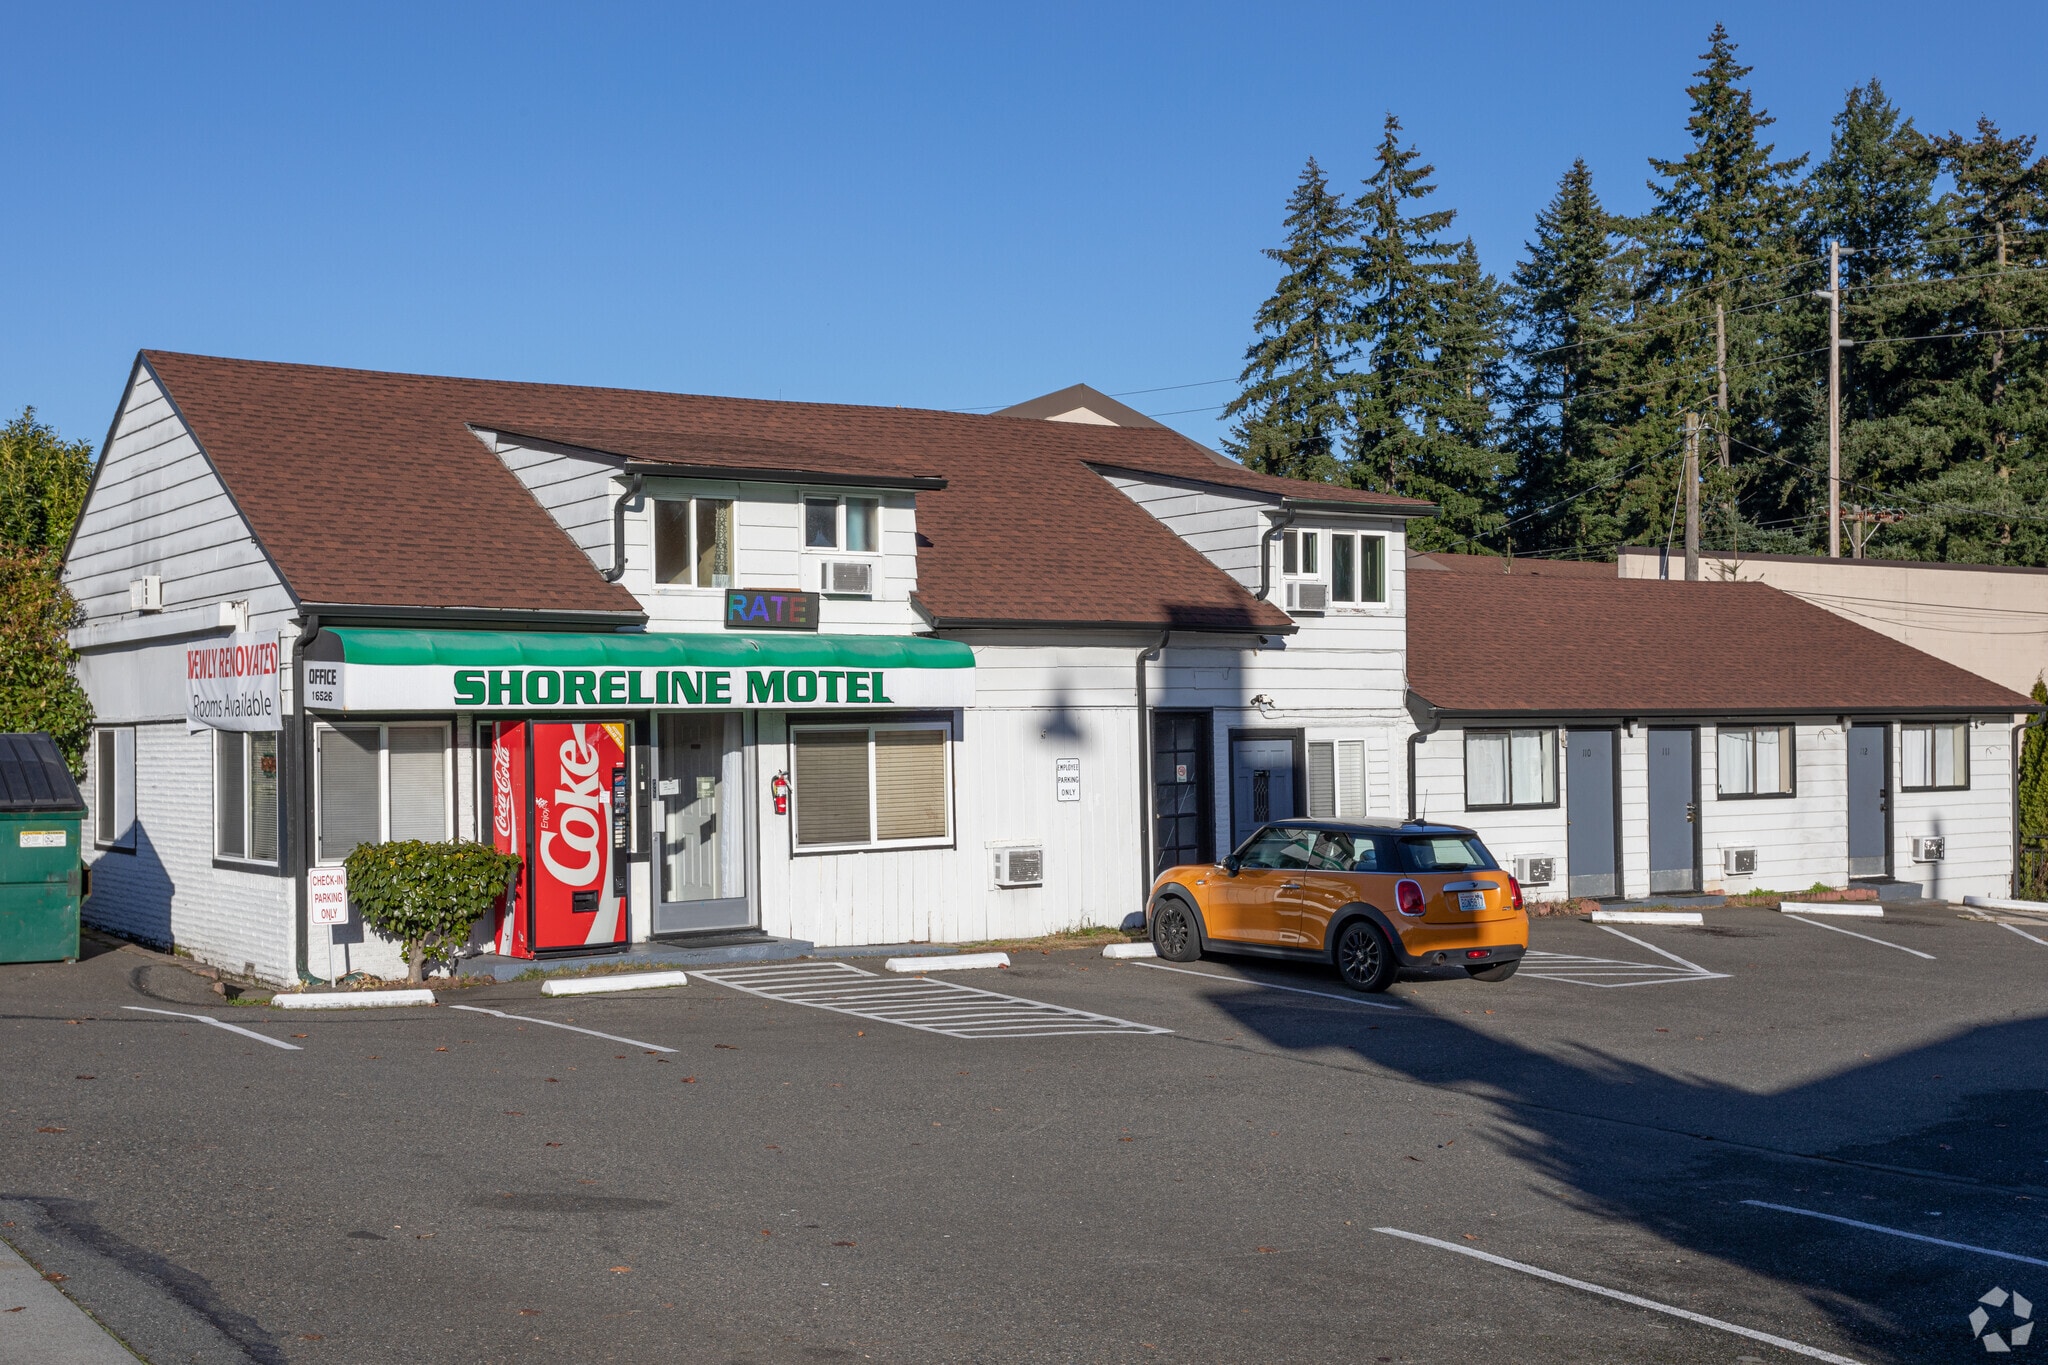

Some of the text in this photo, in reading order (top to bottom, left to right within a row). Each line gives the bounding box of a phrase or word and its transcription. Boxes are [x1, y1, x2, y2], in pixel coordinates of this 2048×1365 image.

[728, 594, 807, 623] RATE
[187, 641, 278, 680] NEWLY RENOVATED
[309, 668, 336, 686] OFFICE
[454, 669, 895, 706] SHORELINE MOTEL
[312, 691, 333, 702] 16526
[193, 690, 272, 718] Rooms Available
[1582, 748, 1591, 758] 110
[1662, 747, 1670, 756] 111
[1057, 763, 1079, 771] EMPLOYEE
[540, 738, 600, 887] Coke
[540, 804, 551, 829] Enjoy
[312, 875, 343, 886] CHECK-IN
[314, 892, 343, 903] PARKING
[321, 908, 338, 919] ONLY
